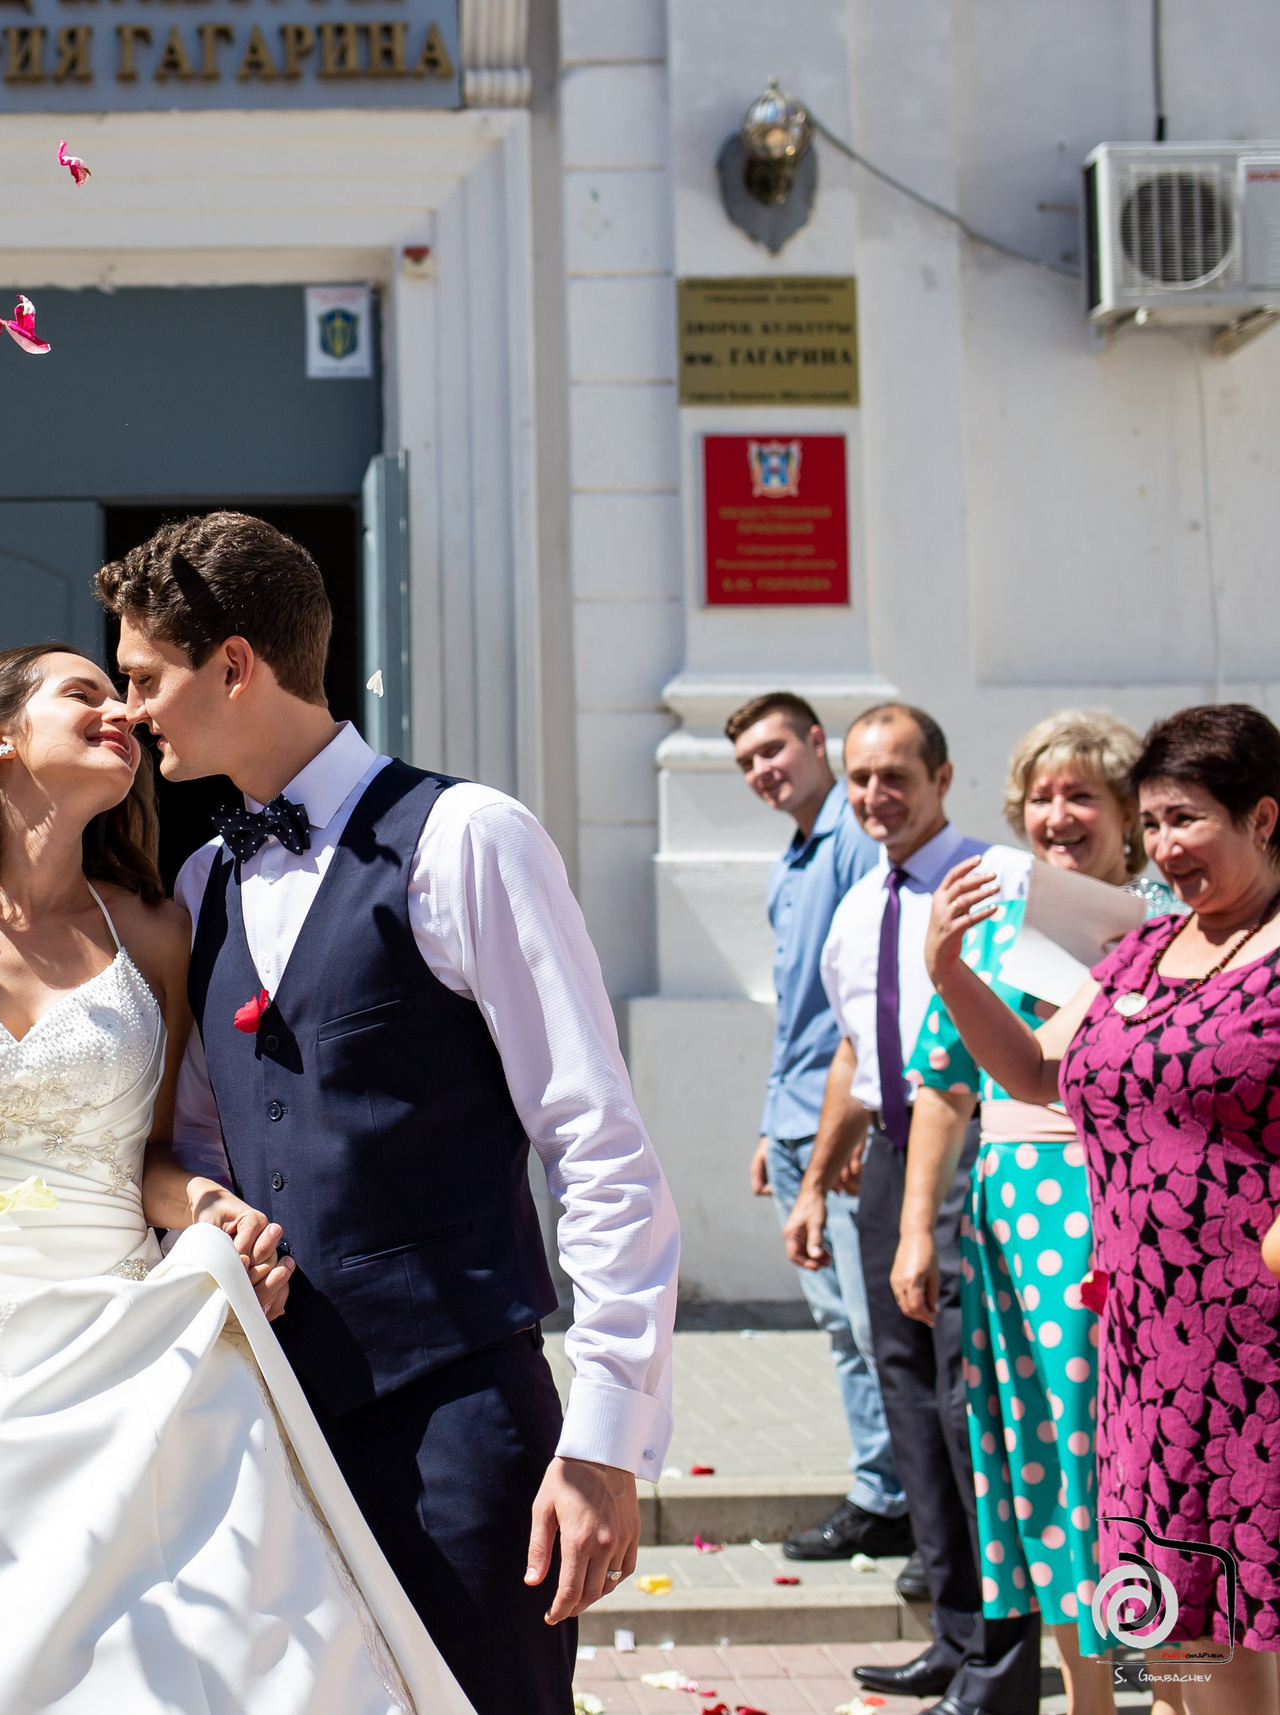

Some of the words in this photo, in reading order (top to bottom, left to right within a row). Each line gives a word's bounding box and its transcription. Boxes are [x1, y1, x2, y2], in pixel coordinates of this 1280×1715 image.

[115, 20, 456, 83] ГАГАРИНА
[686, 321, 752, 336] ДВОРЕЦ
[761, 320, 852, 336] КУЛЬТУРЫ
[729, 348, 852, 367] ГАГАРИНА
